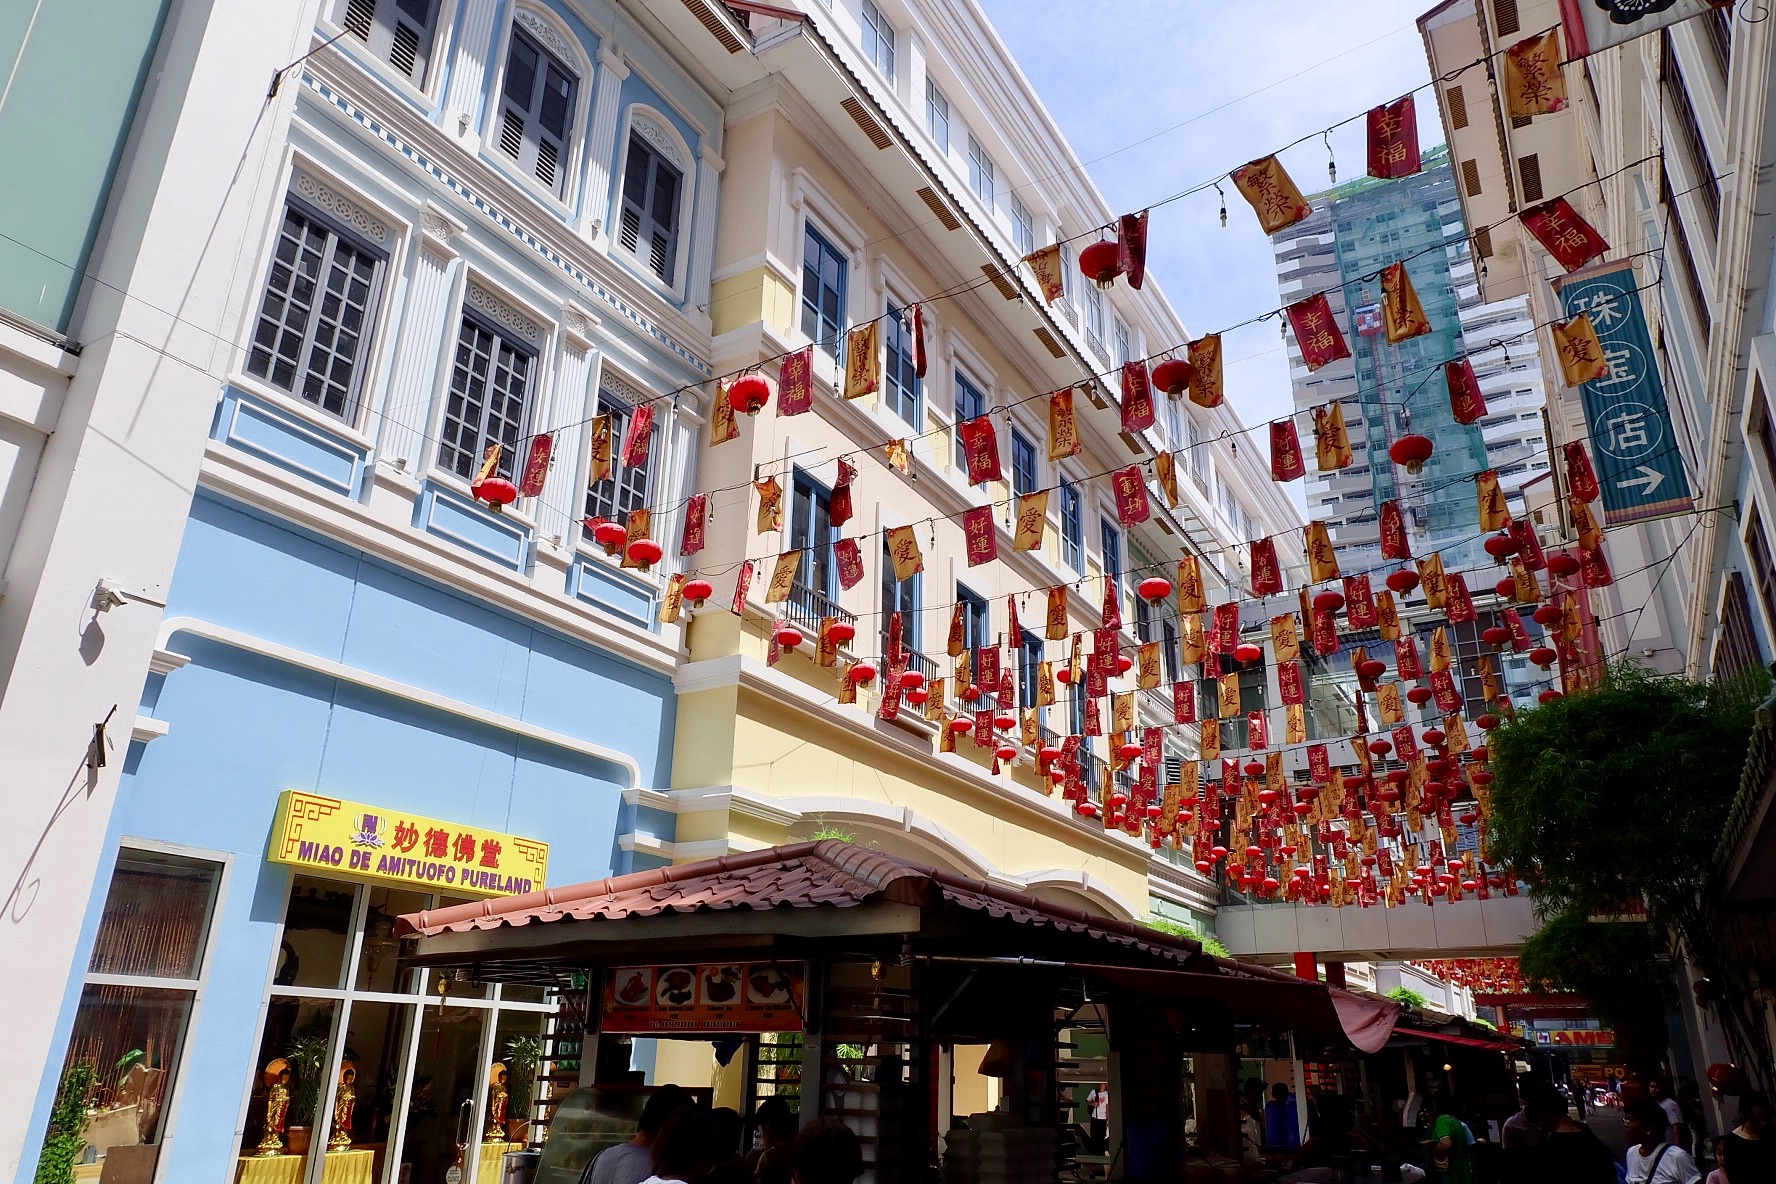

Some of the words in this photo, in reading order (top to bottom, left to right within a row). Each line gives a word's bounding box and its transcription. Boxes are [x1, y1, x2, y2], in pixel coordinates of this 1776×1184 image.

[1518, 51, 1553, 105] 繁榮
[1377, 112, 1407, 164] 幸福
[1247, 169, 1293, 220] 繁榮
[1538, 210, 1587, 253] 幸福
[1301, 311, 1335, 352] 幸福
[1563, 337, 1598, 367] 愛
[786, 360, 804, 404] 幸福
[1574, 291, 1648, 450] 珠宝店
[1055, 407, 1073, 448] 繁榮
[1323, 421, 1345, 453] 愛
[970, 432, 991, 470] 幸福
[1020, 507, 1042, 535] 愛
[971, 518, 991, 554] 好運
[894, 538, 916, 564] 愛
[1310, 538, 1332, 564] 愛
[777, 566, 792, 589] 愛
[840, 552, 858, 579] 好運
[1255, 552, 1275, 584] 好運
[1181, 573, 1201, 600] 愛
[1425, 570, 1446, 596] 愛
[1350, 585, 1371, 619] 好運
[1050, 606, 1066, 625] 愛
[1381, 606, 1398, 628] 愛
[950, 622, 963, 642] 愛
[1275, 628, 1295, 648] 愛
[1098, 639, 1115, 668] 好運
[1399, 643, 1416, 671] 好運
[981, 654, 994, 683] 好運
[1142, 658, 1158, 678] 愛
[1039, 675, 1052, 694] 愛
[1282, 670, 1298, 697] 好運
[1434, 678, 1453, 704] 好運
[885, 686, 899, 711] 好運
[929, 692, 942, 710] 愛
[1177, 690, 1191, 717] 好運
[1221, 687, 1238, 706] 愛
[1381, 695, 1400, 714] 愛
[1116, 702, 1130, 721] 愛
[1288, 714, 1302, 733] 愛
[977, 717, 992, 740] 好運
[1024, 719, 1035, 735] 愛
[1147, 736, 1159, 760] 好運
[1203, 732, 1217, 750] 愛
[1396, 731, 1414, 754] 好運
[1311, 752, 1327, 776] 好運
[1067, 776, 1077, 790] 愛
[1142, 774, 1154, 790] 愛
[1184, 768, 1194, 792] 財富
[1224, 768, 1238, 785] 愛
[1135, 794, 1146, 809] 愛
[1268, 807, 1279, 820] 愛
[1346, 797, 1358, 811] 愛
[1381, 815, 1390, 828] 愛
[392, 820, 501, 868] 妙德佛堂
[1334, 839, 1346, 852] 愛
[298, 841, 343, 864] MIAO
[350, 852, 370, 869] DE
[376, 854, 456, 883] AMITUOFO
[461, 868, 532, 894] PURELAND
[1254, 860, 1264, 871] 愛
[1315, 862, 1326, 874] 愛
[1380, 857, 1391, 869] 愛
